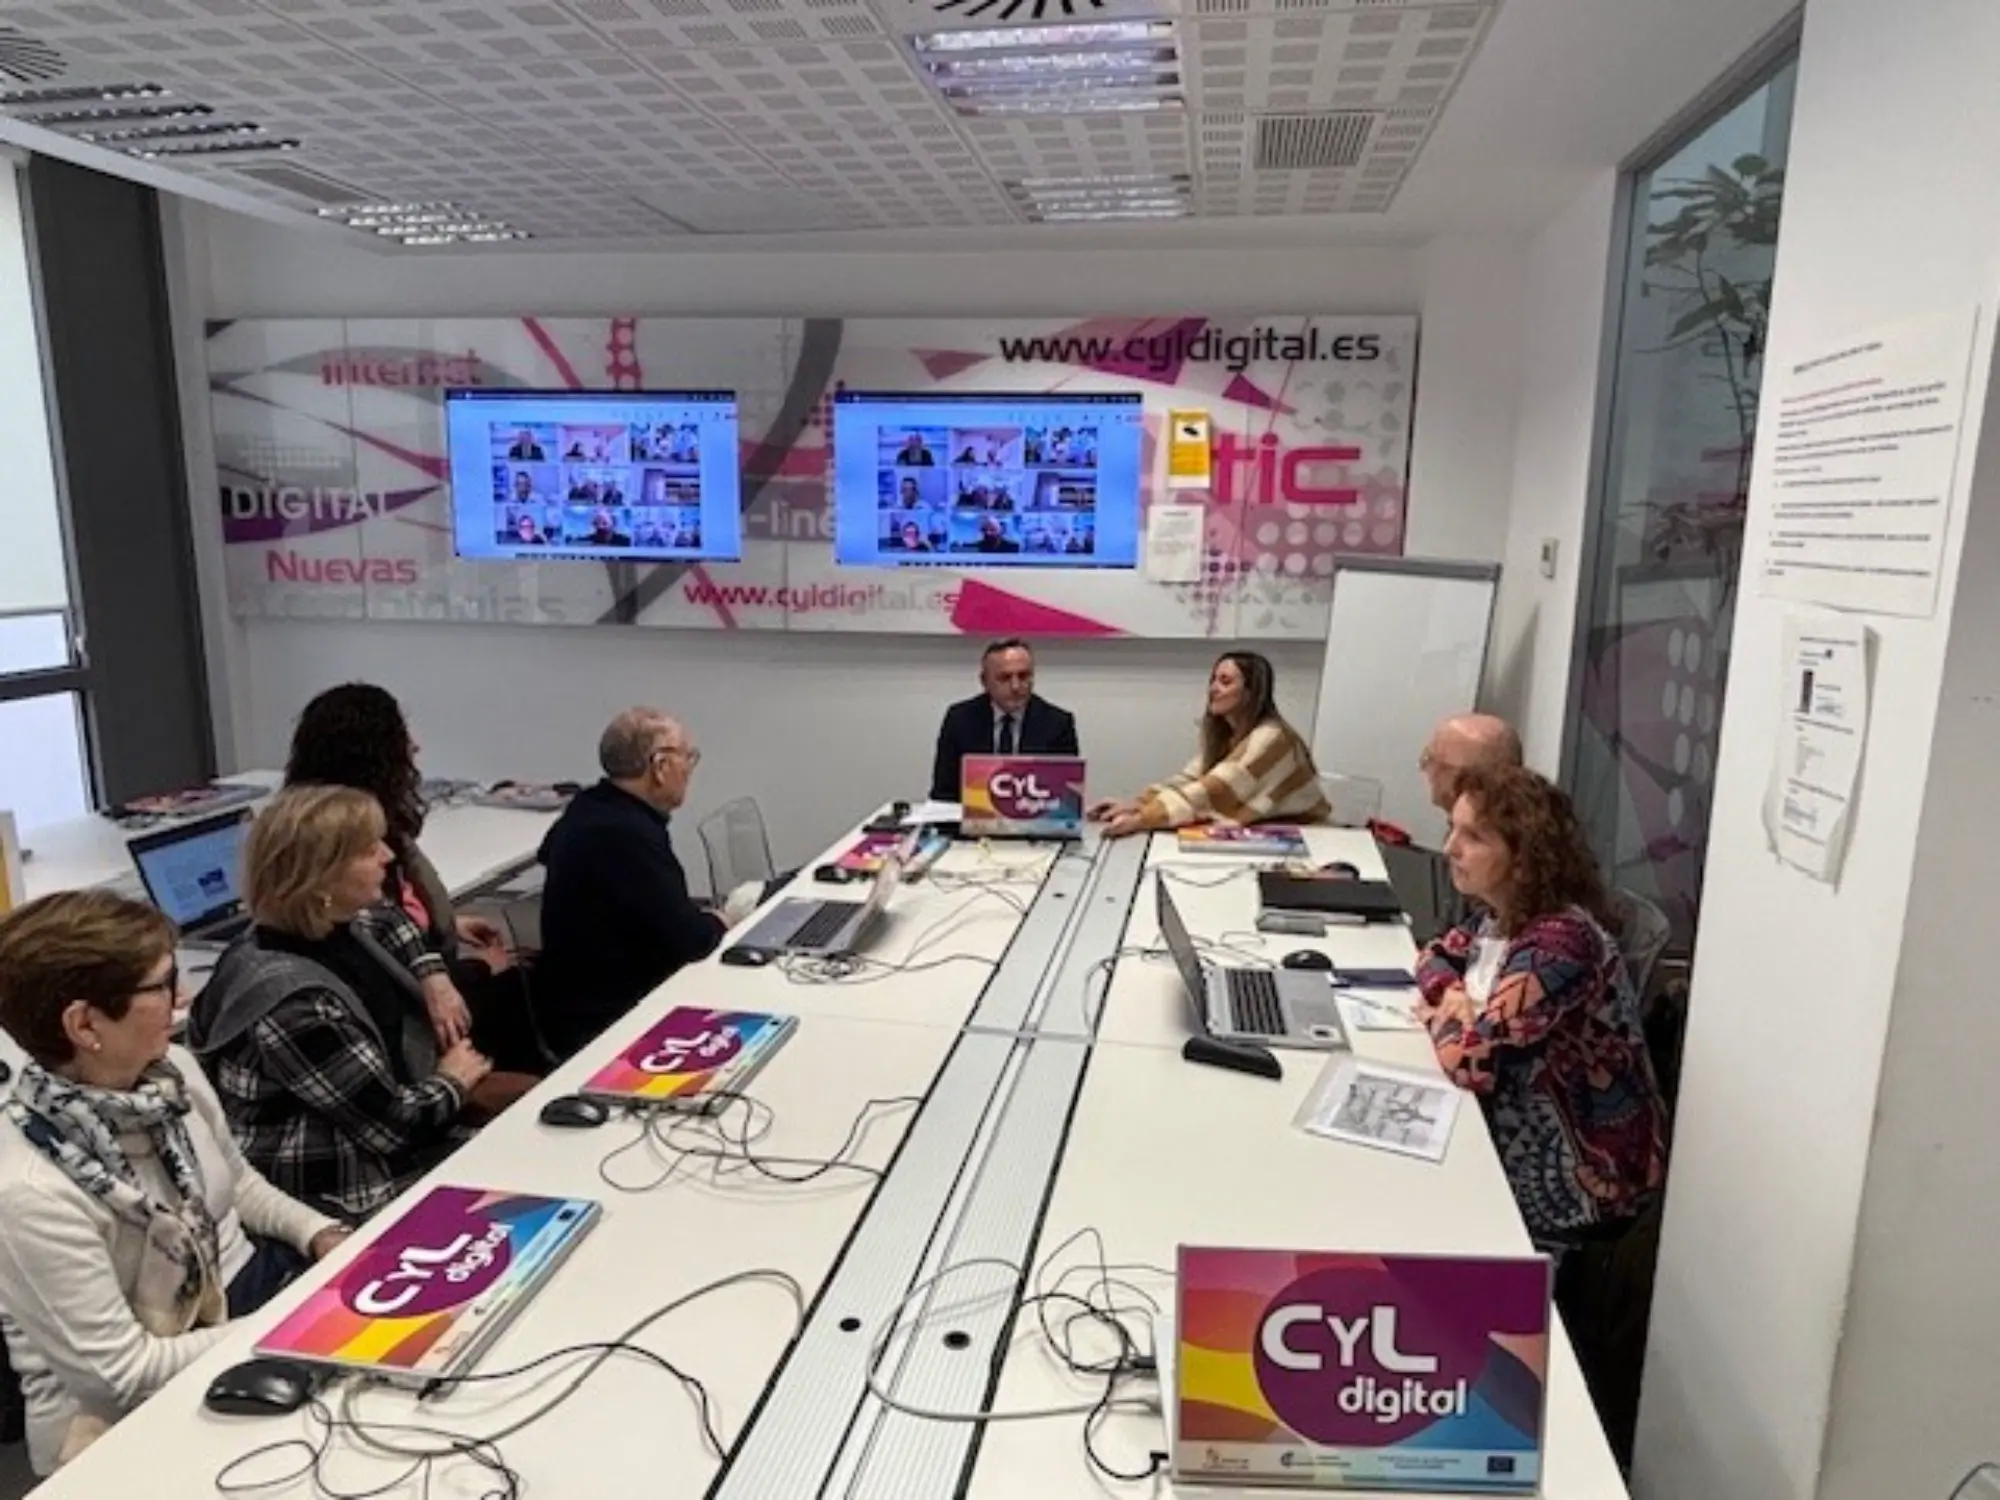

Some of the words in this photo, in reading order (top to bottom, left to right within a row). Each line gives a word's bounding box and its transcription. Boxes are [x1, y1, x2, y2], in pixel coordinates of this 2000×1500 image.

[999, 327, 1381, 372] www.cyldigital.es
[1211, 433, 1362, 504] tic
[267, 550, 418, 586] Nuevas
[1337, 1375, 1468, 1424] digital
